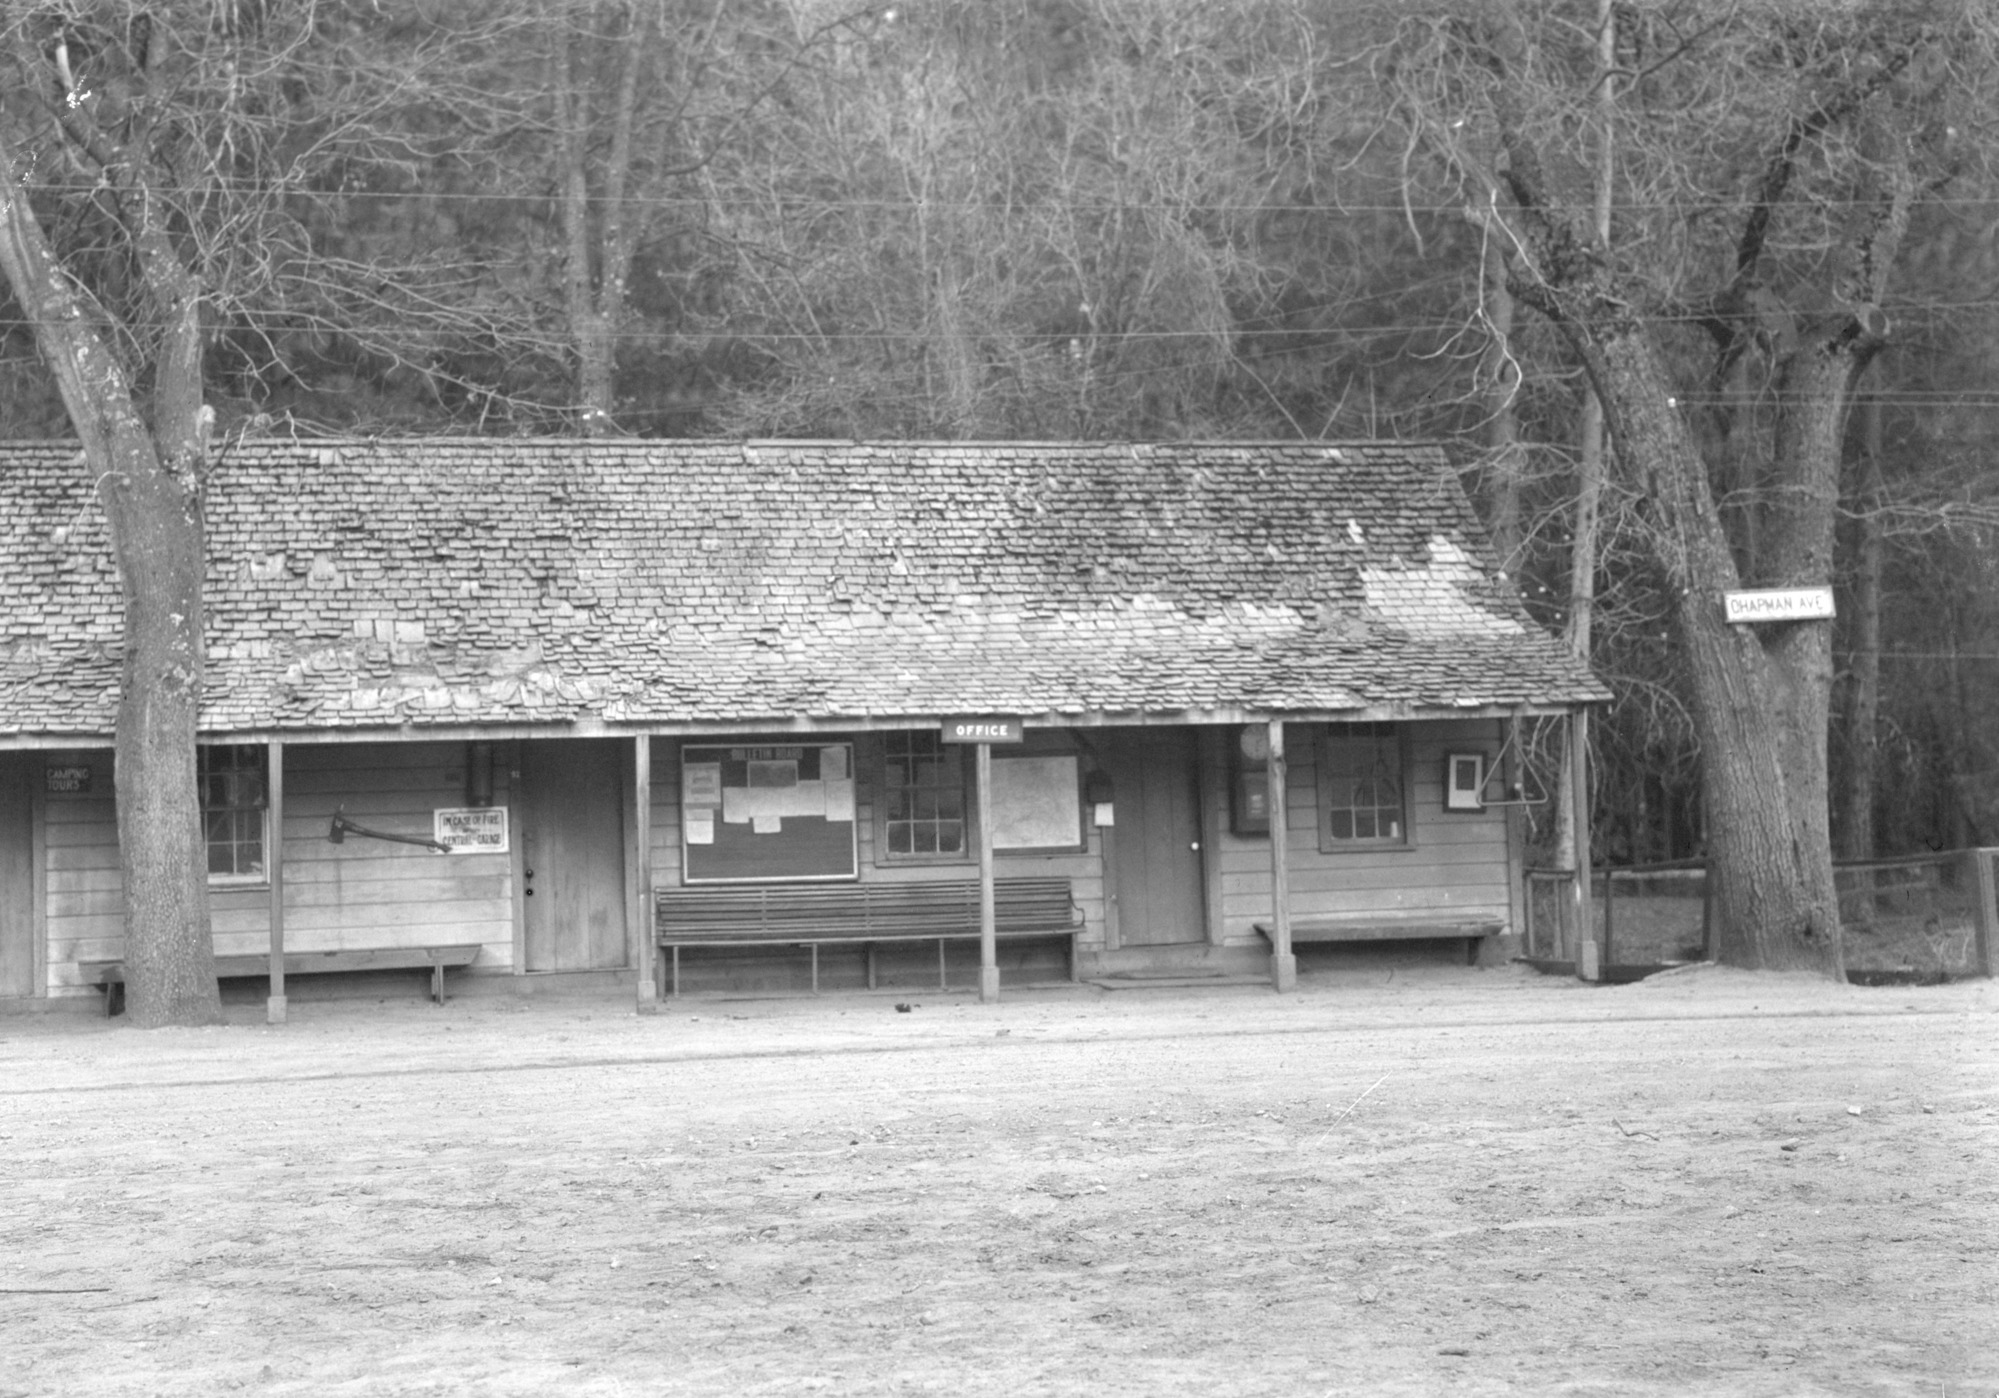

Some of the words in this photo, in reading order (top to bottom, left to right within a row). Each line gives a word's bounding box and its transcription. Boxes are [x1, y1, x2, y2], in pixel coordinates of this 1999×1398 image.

[1731, 597, 1792, 614] CHAPMAN
[1800, 595, 1823, 610] AVE
[956, 724, 1008, 736] OFFICE
[48, 780, 80, 791] TOURS
[453, 815, 471, 826] CASE
[483, 814, 500, 825] FIRE
